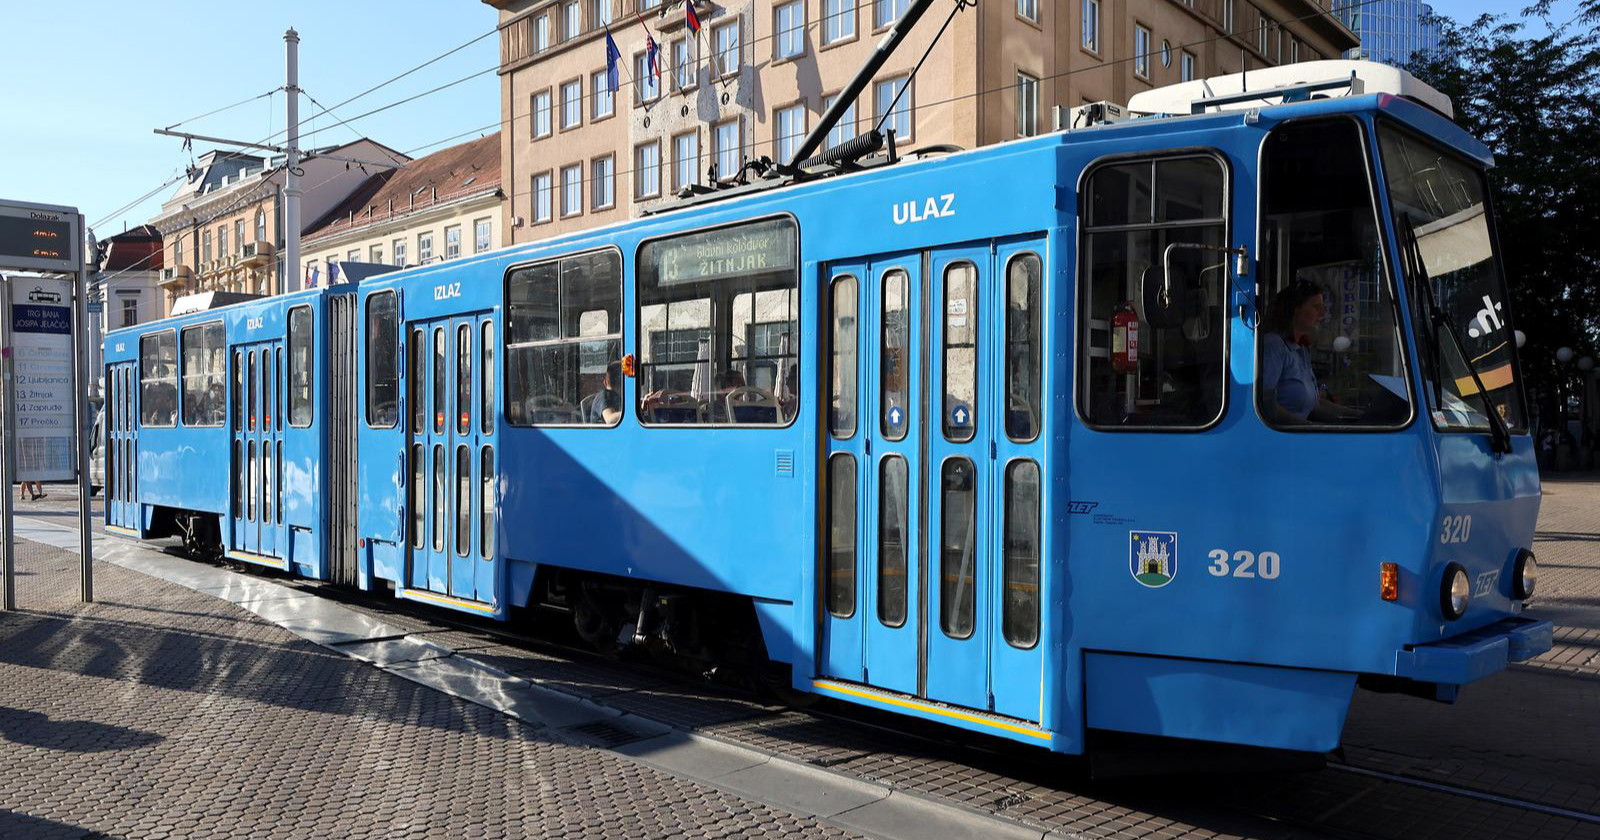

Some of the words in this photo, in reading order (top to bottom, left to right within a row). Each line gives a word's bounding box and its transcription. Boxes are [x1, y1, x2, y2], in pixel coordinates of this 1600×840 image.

[893, 193, 956, 225] ULAZ
[30, 211, 60, 222] Dolazak
[726, 236, 769, 253] kolodvor
[700, 254, 766, 276] ŽITNJAK
[434, 282, 461, 300] IZLAZ
[27, 309, 41, 318] TRG
[42, 310, 60, 319] BANA
[15, 319, 39, 328] JOSIPA
[15, 376, 26, 384] 12
[28, 376, 69, 384] Ljubljanica
[16, 390, 27, 399] 13
[16, 403, 27, 412] 14
[19, 417, 29, 426] 17
[1067, 501, 1099, 514] ZET
[1440, 514, 1472, 545] 320
[1207, 548, 1281, 580] 320
[1473, 569, 1499, 598] ZET
